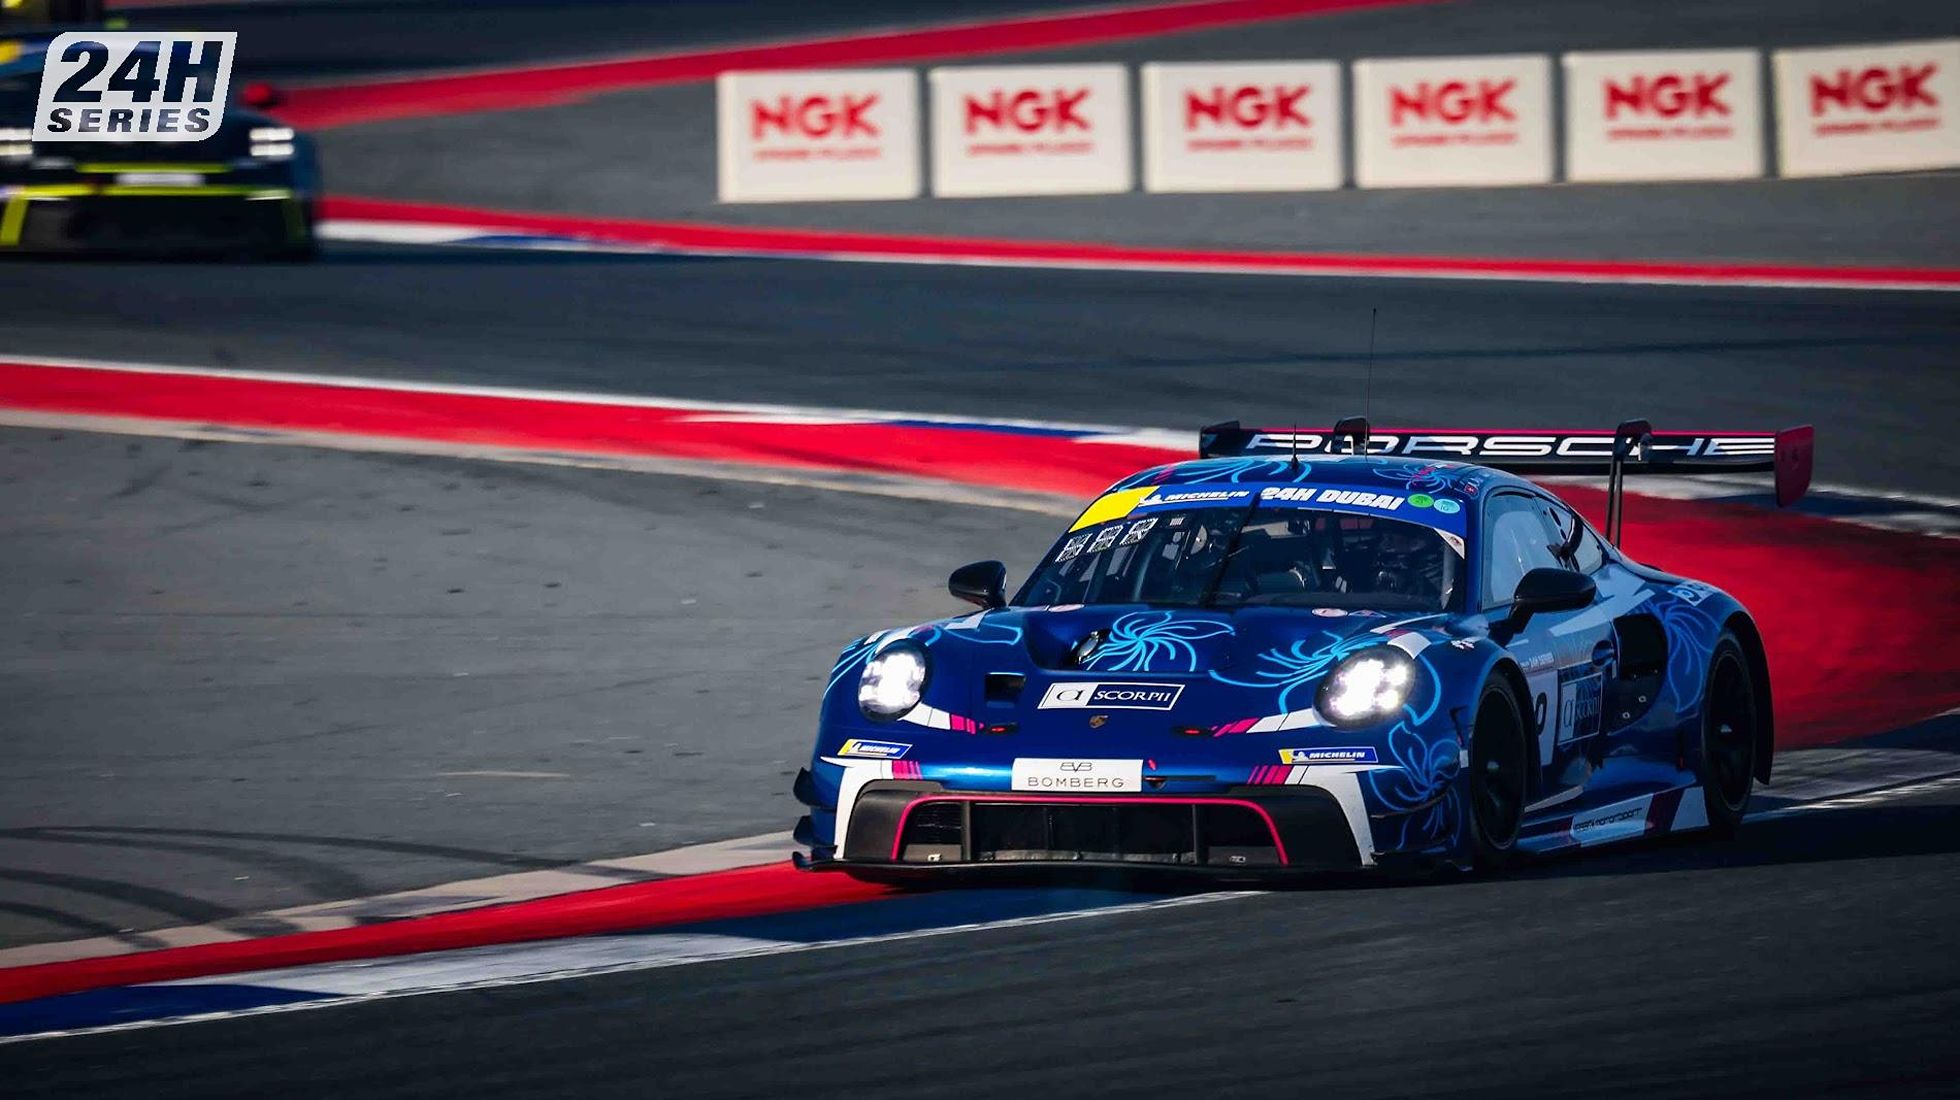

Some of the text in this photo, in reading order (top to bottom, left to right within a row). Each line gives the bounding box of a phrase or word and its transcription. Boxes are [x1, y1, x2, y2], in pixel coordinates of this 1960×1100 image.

[1388, 78, 1517, 127] NGK
[1602, 72, 1731, 120] NGK
[1809, 62, 1938, 117] NGK
[750, 94, 880, 141] NGK
[963, 88, 1092, 135] NGK
[1184, 84, 1312, 131] NGK
[1246, 433, 1775, 456] PORSCHE
[1164, 490, 1250, 501] MICHELIN
[1260, 487, 1317, 502] 24H
[1316, 489, 1405, 511] DUBAI
[1094, 690, 1171, 702] SCORPII
[1309, 751, 1366, 759] MICHELIN
[1027, 776, 1124, 788] BOMBERG
